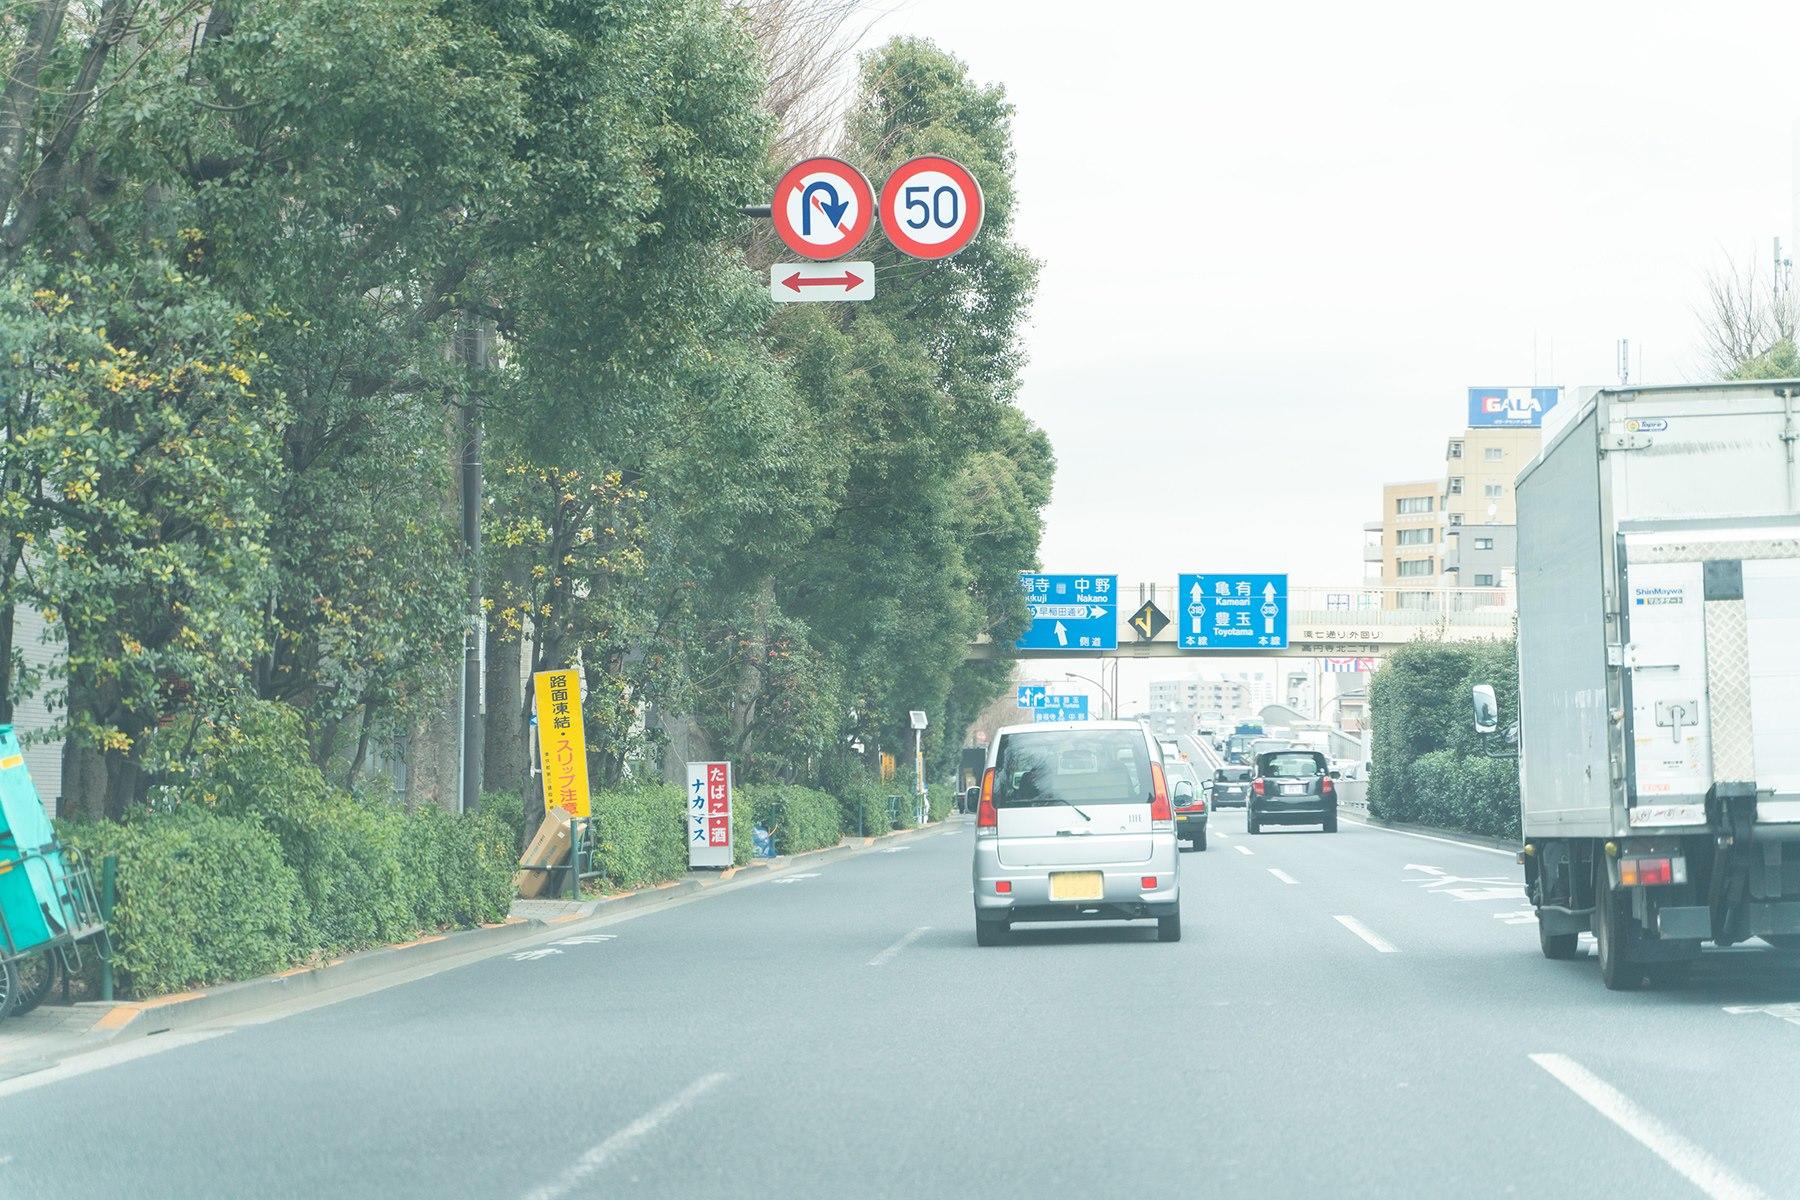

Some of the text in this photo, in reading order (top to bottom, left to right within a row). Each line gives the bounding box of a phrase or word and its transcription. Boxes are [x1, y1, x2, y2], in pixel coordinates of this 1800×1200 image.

[906, 185, 959, 230] 50
[1484, 397, 1543, 412] GALA
[1074, 577, 1110, 593] 中野
[1215, 581, 1252, 596] 亀有
[1635, 588, 1683, 596] ShinMaywa
[1076, 594, 1109, 603] Nakano
[1215, 598, 1251, 606] Kameari
[1039, 607, 1085, 617] 早稲田通り
[1215, 612, 1252, 626] 豊玉
[1213, 628, 1254, 637] Toyotama
[1185, 636, 1208, 646] 本線
[1258, 636, 1281, 646] 本線
[691, 778, 706, 842] ナカマス
[710, 767, 726, 843] たばこ・酒
